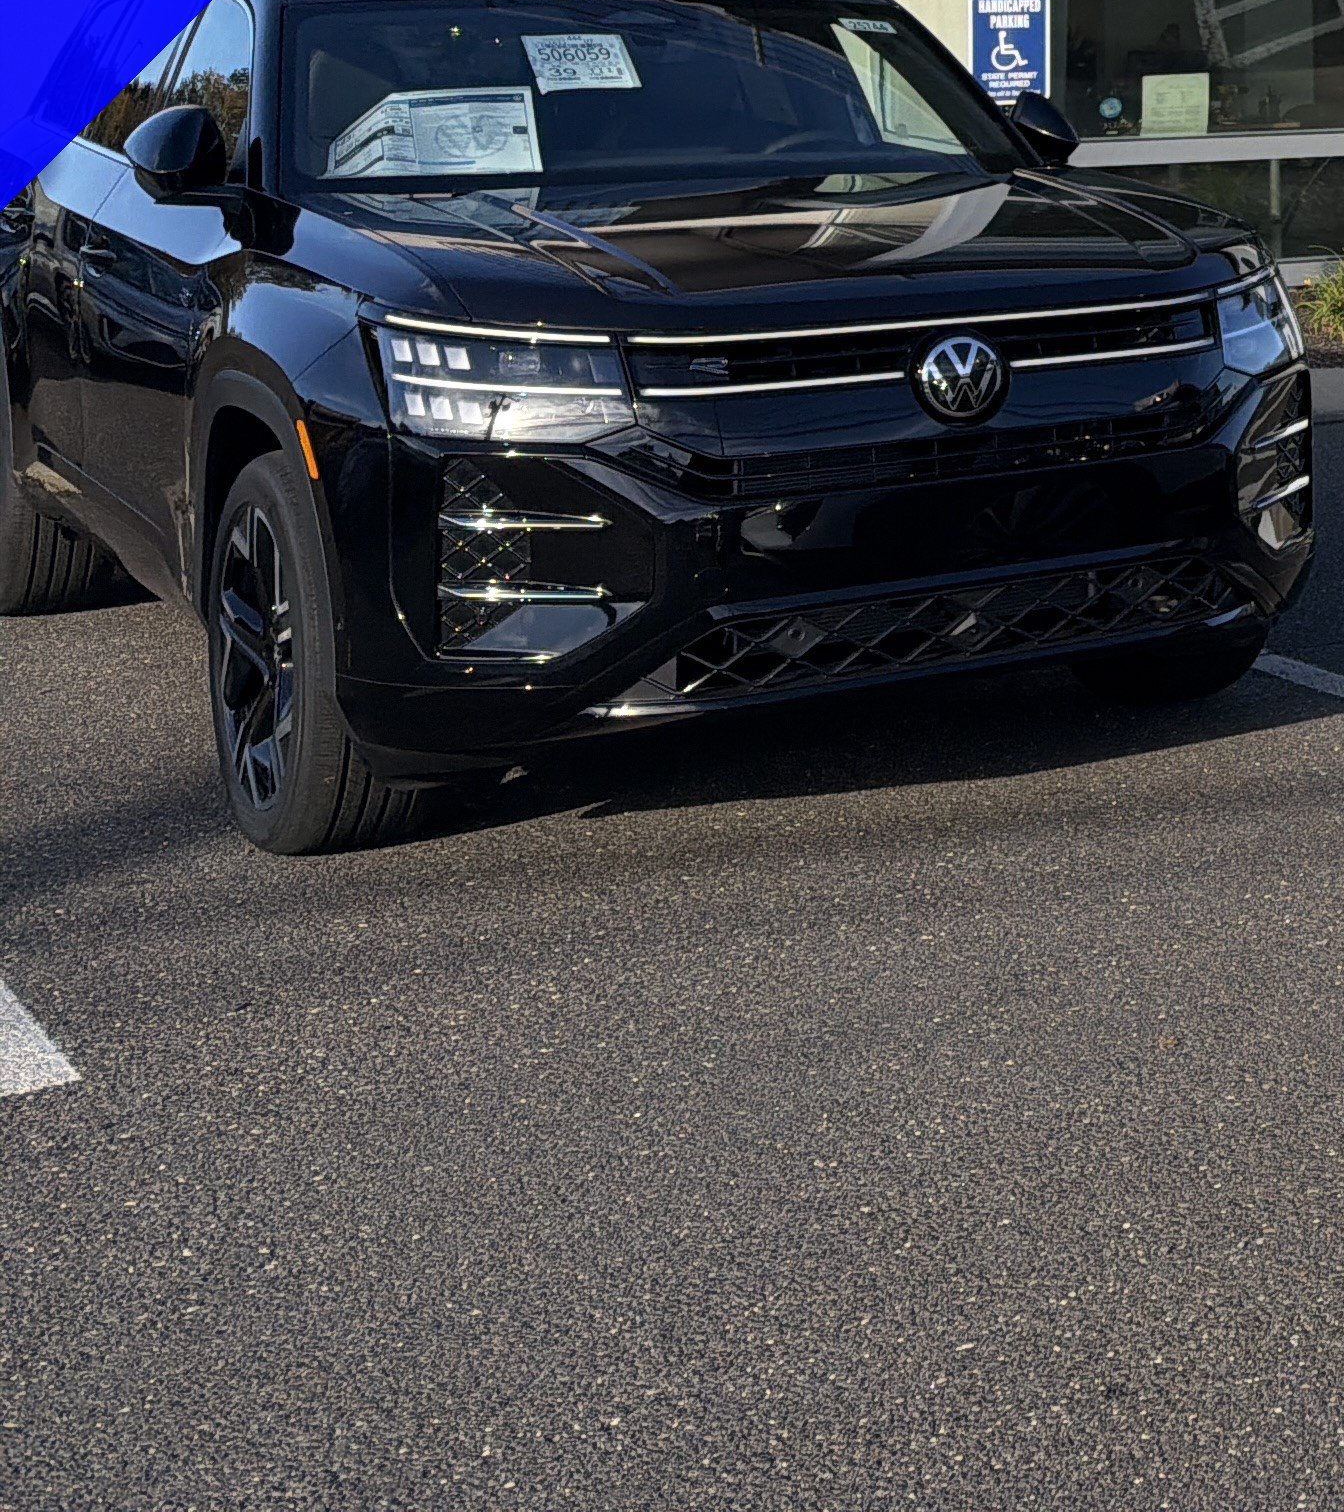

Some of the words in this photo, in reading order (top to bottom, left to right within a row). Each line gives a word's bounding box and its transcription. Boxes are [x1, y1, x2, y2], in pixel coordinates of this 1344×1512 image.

[990, 14, 1030, 29] PARKING
[537, 47, 611, 62] 506059
[548, 68, 577, 77] 39
[981, 72, 1006, 81] STATE
[1008, 71, 1038, 80] PERMIT
[989, 80, 1031, 89] REQUIRED
